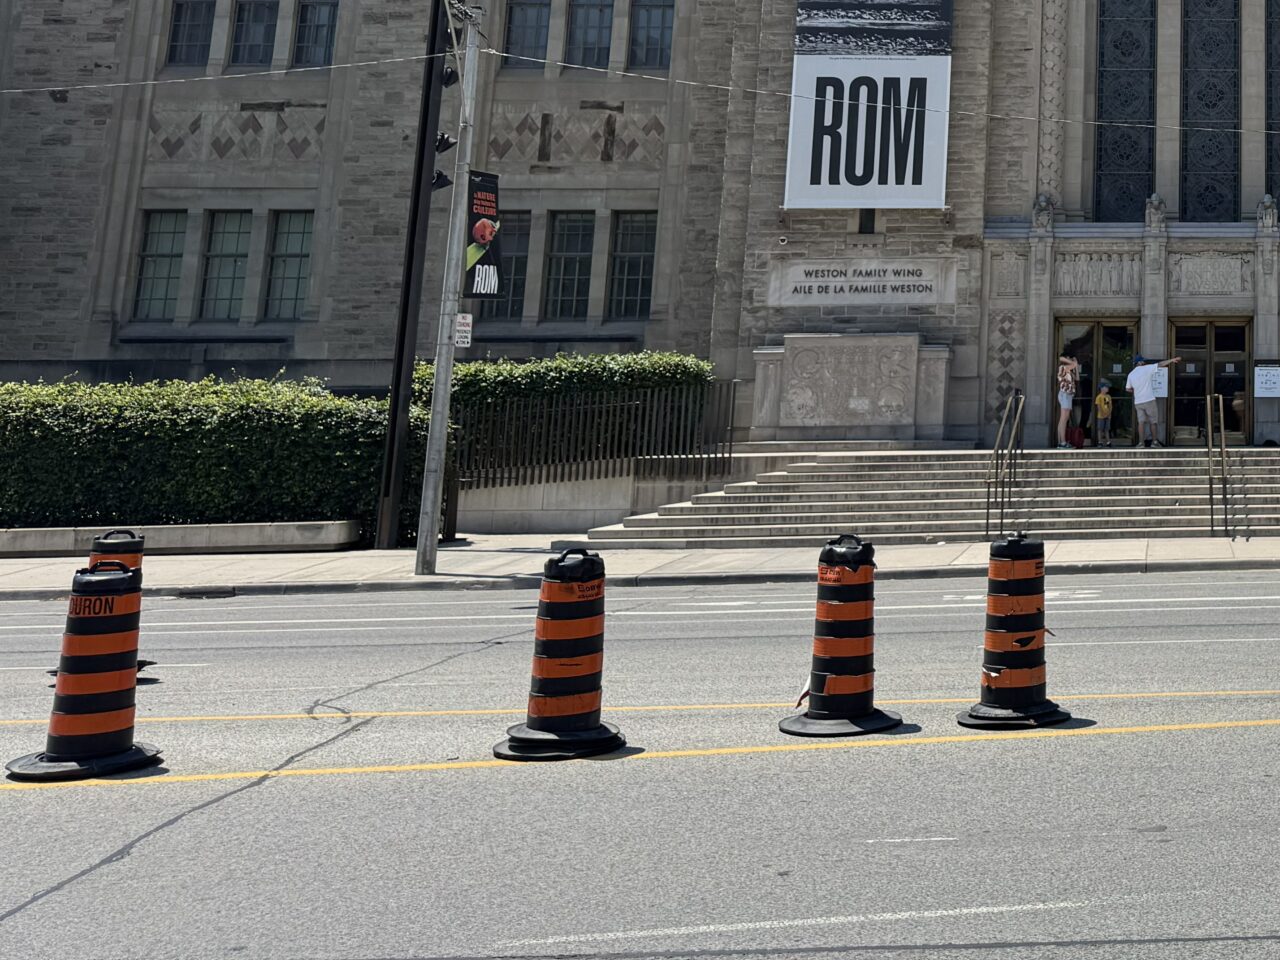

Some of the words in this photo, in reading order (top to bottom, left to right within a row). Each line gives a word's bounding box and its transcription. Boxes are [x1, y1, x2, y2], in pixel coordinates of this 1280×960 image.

[810, 76, 927, 186] ROM
[473, 265, 499, 294] ROM
[804, 269, 847, 278] WESTON
[853, 269, 888, 278] FAMILY
[893, 269, 923, 278] WING
[792, 285, 812, 294] AILE
[817, 285, 829, 294] DE
[833, 285, 845, 294] LA
[848, 285, 887, 294] FAMILLE
[890, 284, 932, 293] WESTON
